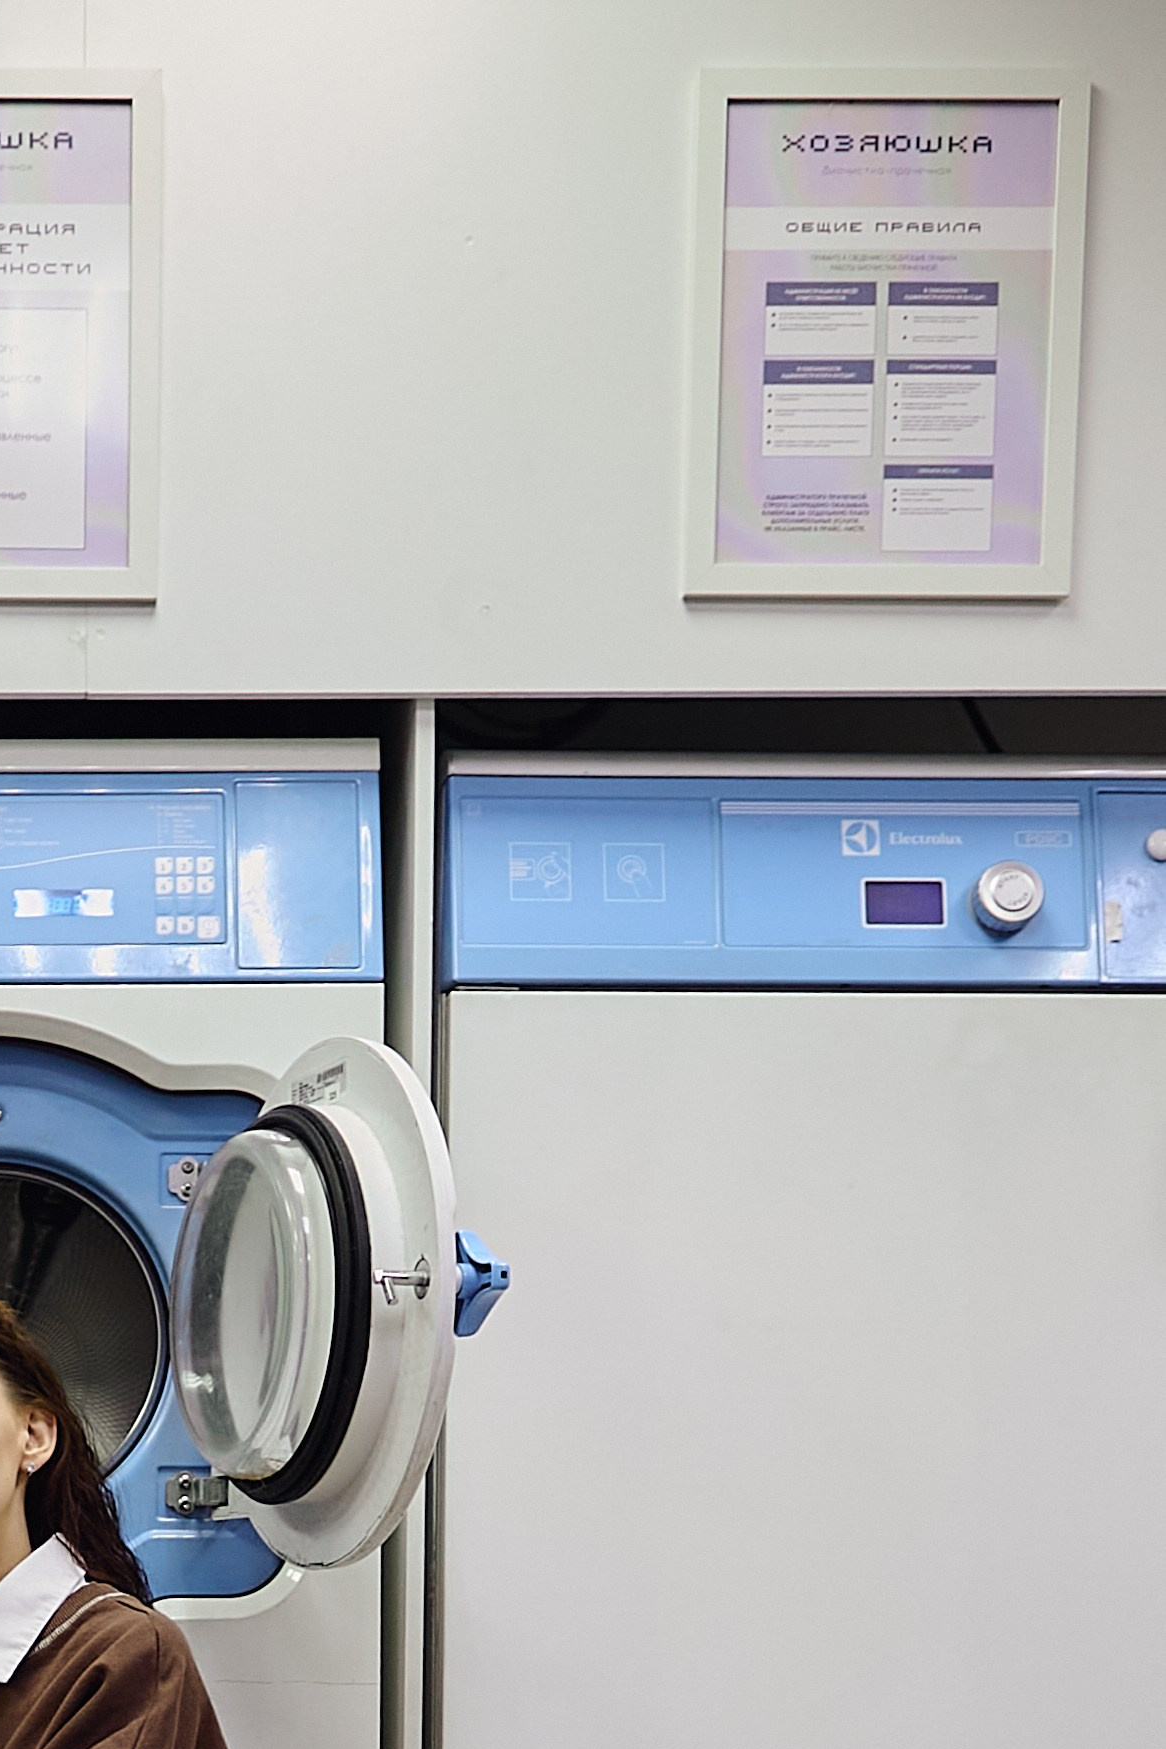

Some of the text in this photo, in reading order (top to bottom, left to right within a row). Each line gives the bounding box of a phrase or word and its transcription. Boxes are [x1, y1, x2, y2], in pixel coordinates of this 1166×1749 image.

[782, 134, 994, 153] ХОЗЯЮШКА
[785, 221, 982, 234] ОБЩИЕ ПРАВИЛА
[888, 832, 963, 845] Electrolux
